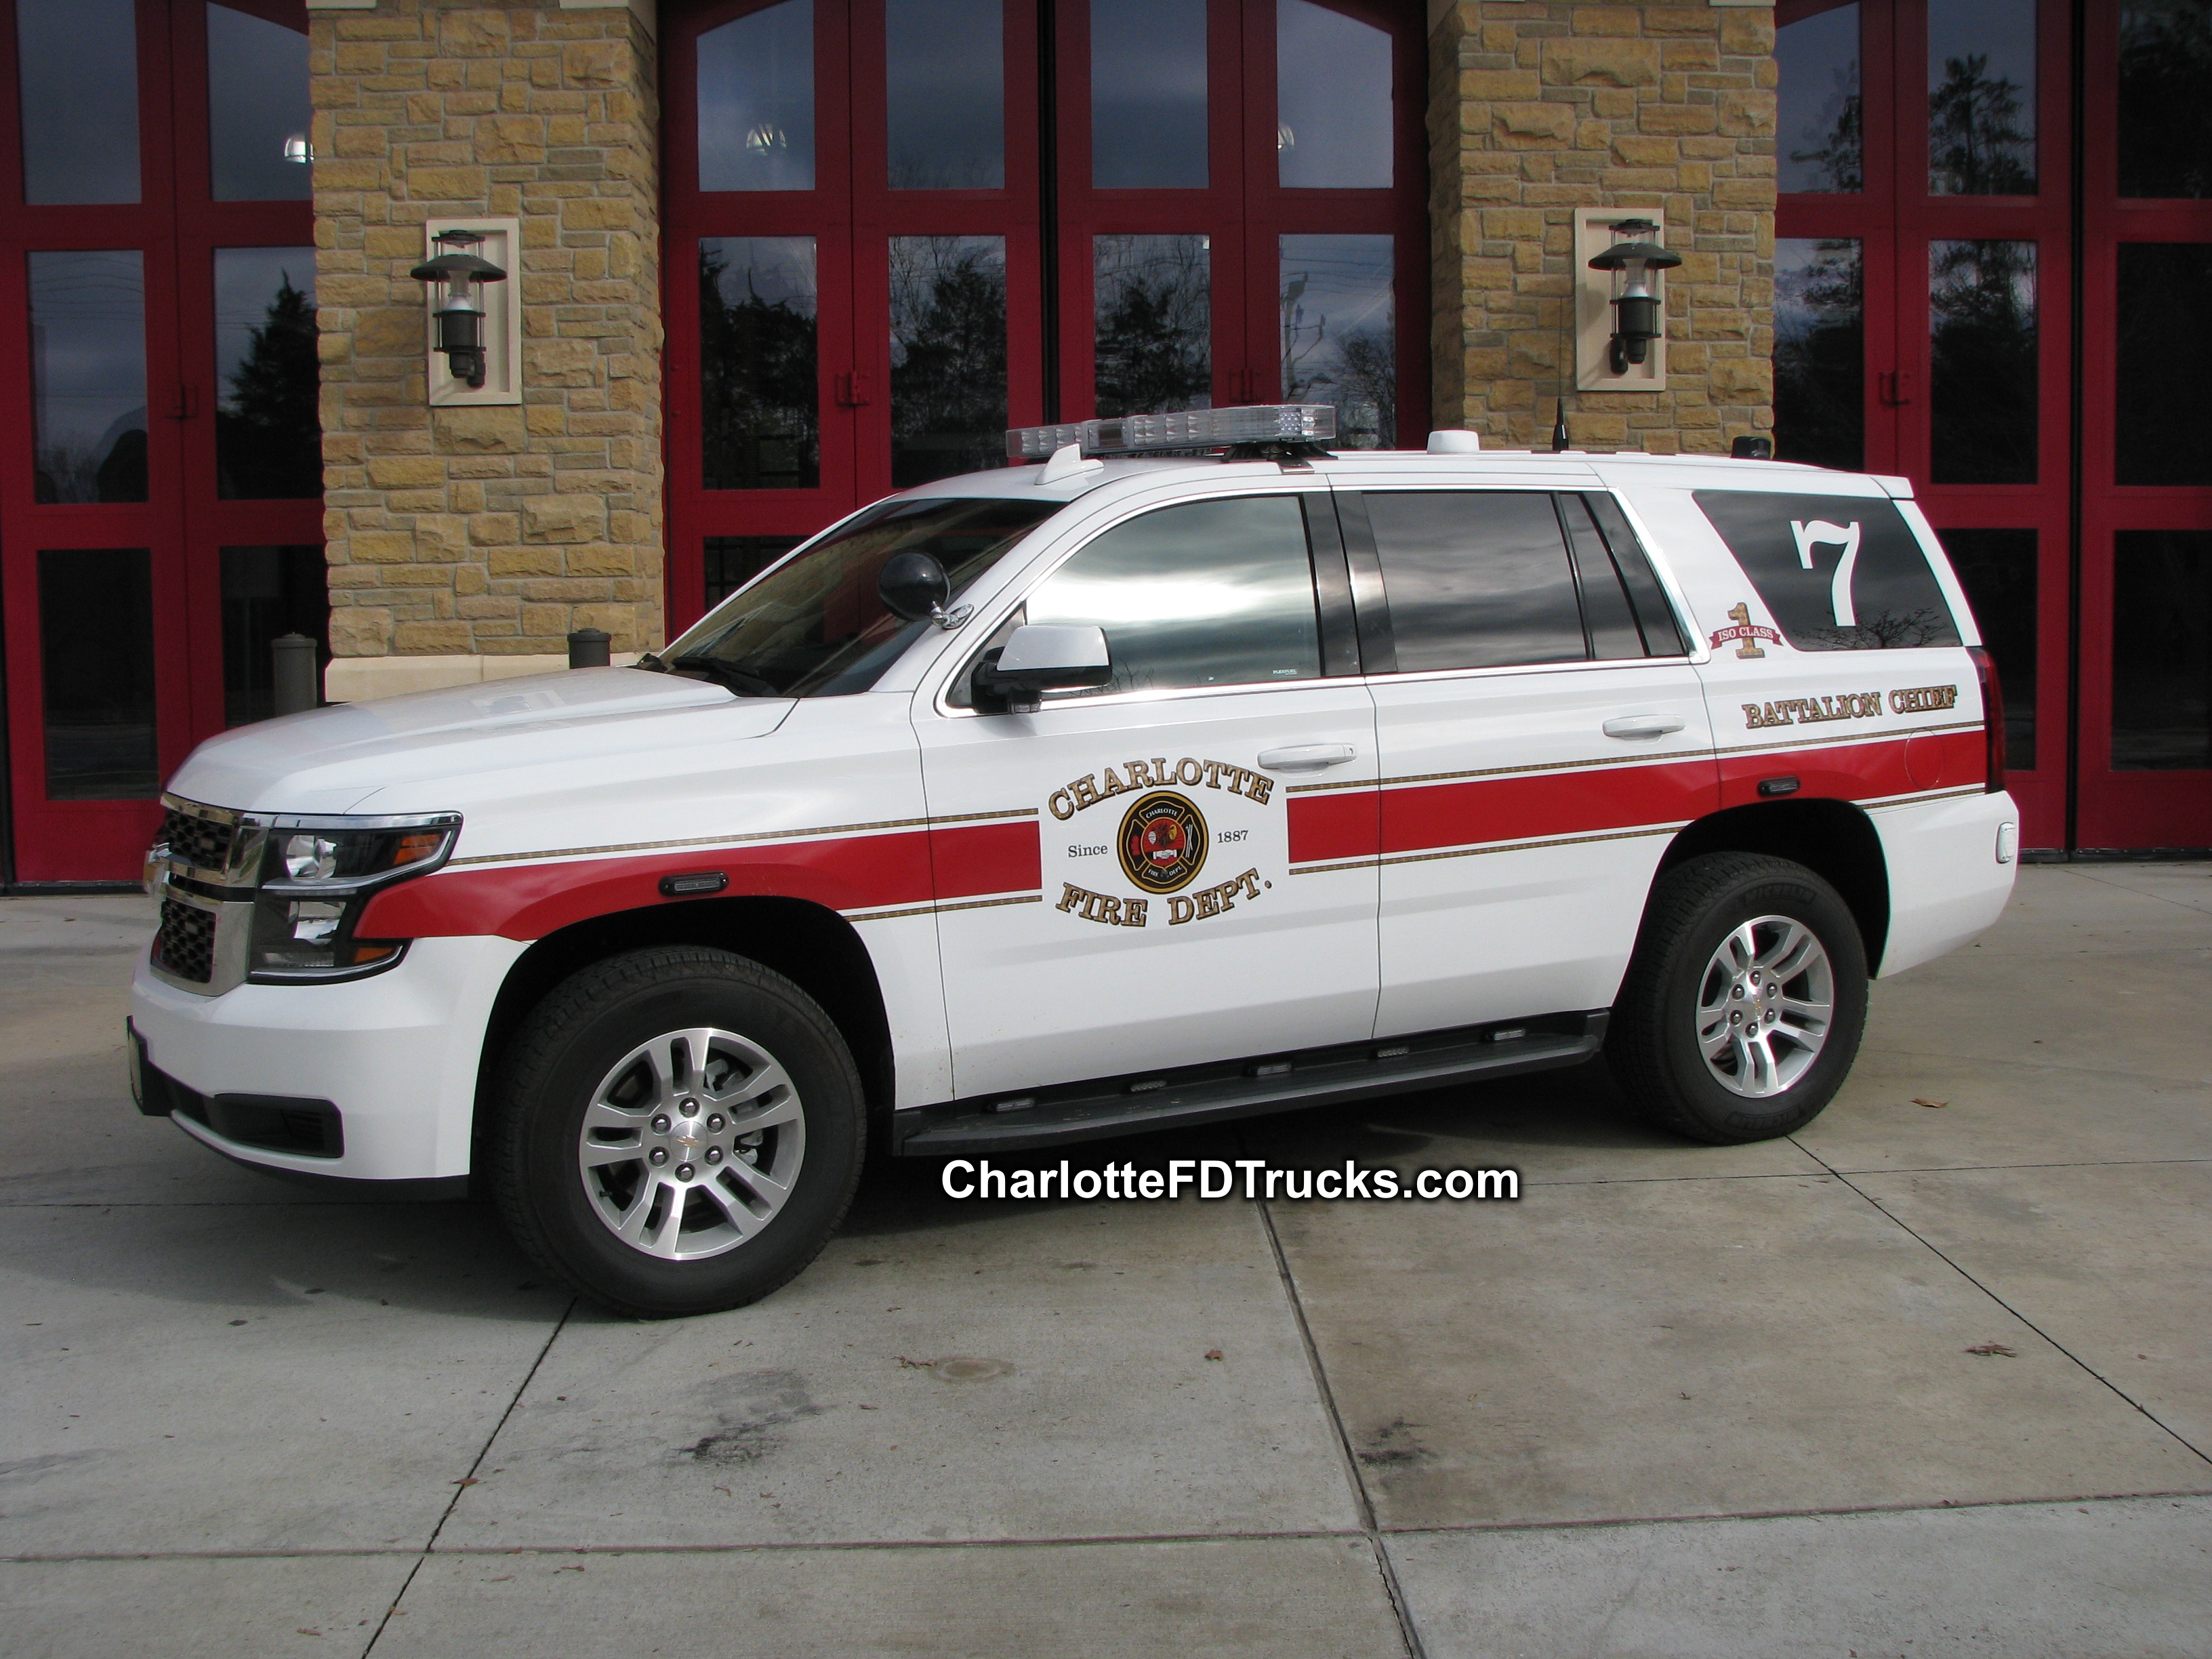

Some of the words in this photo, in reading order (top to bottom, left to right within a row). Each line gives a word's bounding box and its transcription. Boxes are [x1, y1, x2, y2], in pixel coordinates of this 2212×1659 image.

[1790, 520, 1861, 627] 7
[1717, 628, 1736, 641] ISO
[1739, 627, 1774, 638] CLASS
[1727, 602, 1765, 659] 1
[1741, 692, 1882, 729] BATTALION
[1888, 684, 1957, 714] CHIEF
[1048, 758, 1274, 820] CHARLOTTE
[1145, 808, 1178, 819] CHARLOTTE
[1068, 844, 1108, 858] Since
[1217, 830, 1248, 843] 1887
[1056, 882, 1148, 927] FIRE
[1167, 867, 1272, 925] DEPT.
